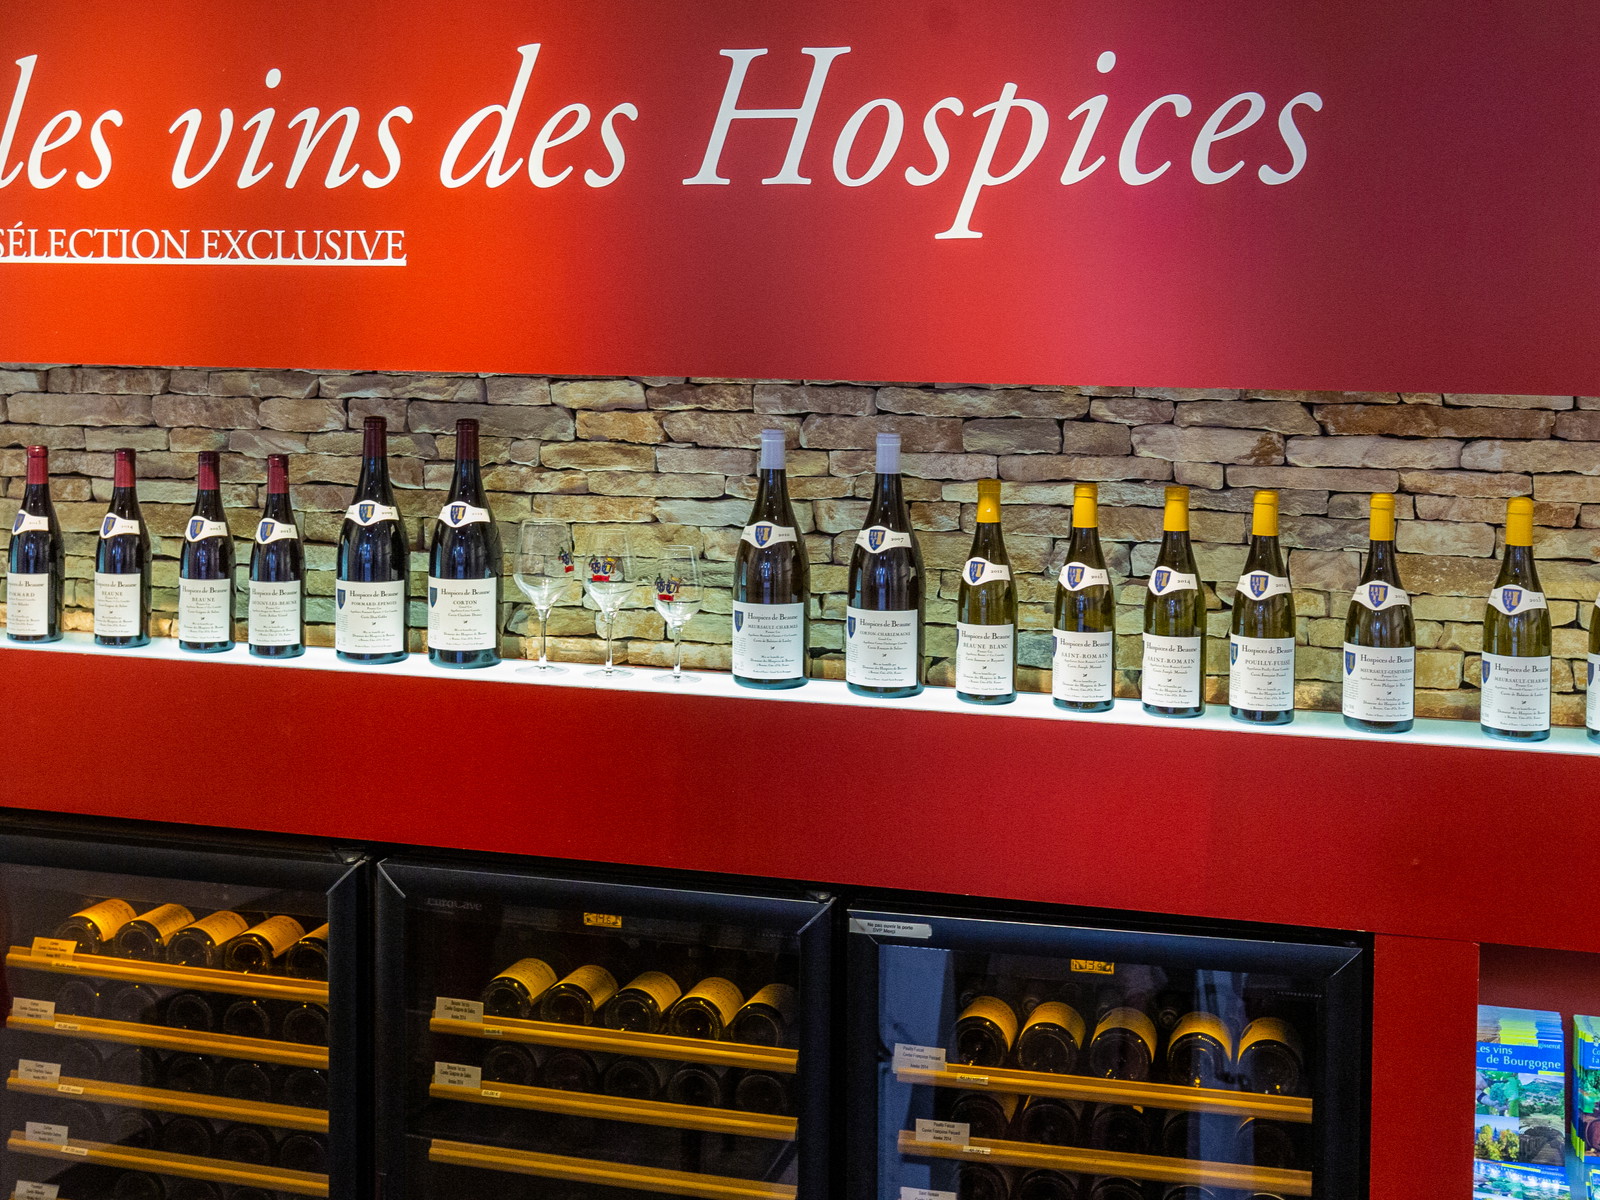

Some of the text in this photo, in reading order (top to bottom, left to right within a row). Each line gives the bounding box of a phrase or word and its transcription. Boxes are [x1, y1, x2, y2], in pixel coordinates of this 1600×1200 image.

[0, 43, 1323, 240] les vins des Hospices
[203, 229, 407, 261] EXCLUSIVE
[1493, 1045, 1512, 1054] vins
[1486, 1055, 1561, 1070] de Bourgogne
